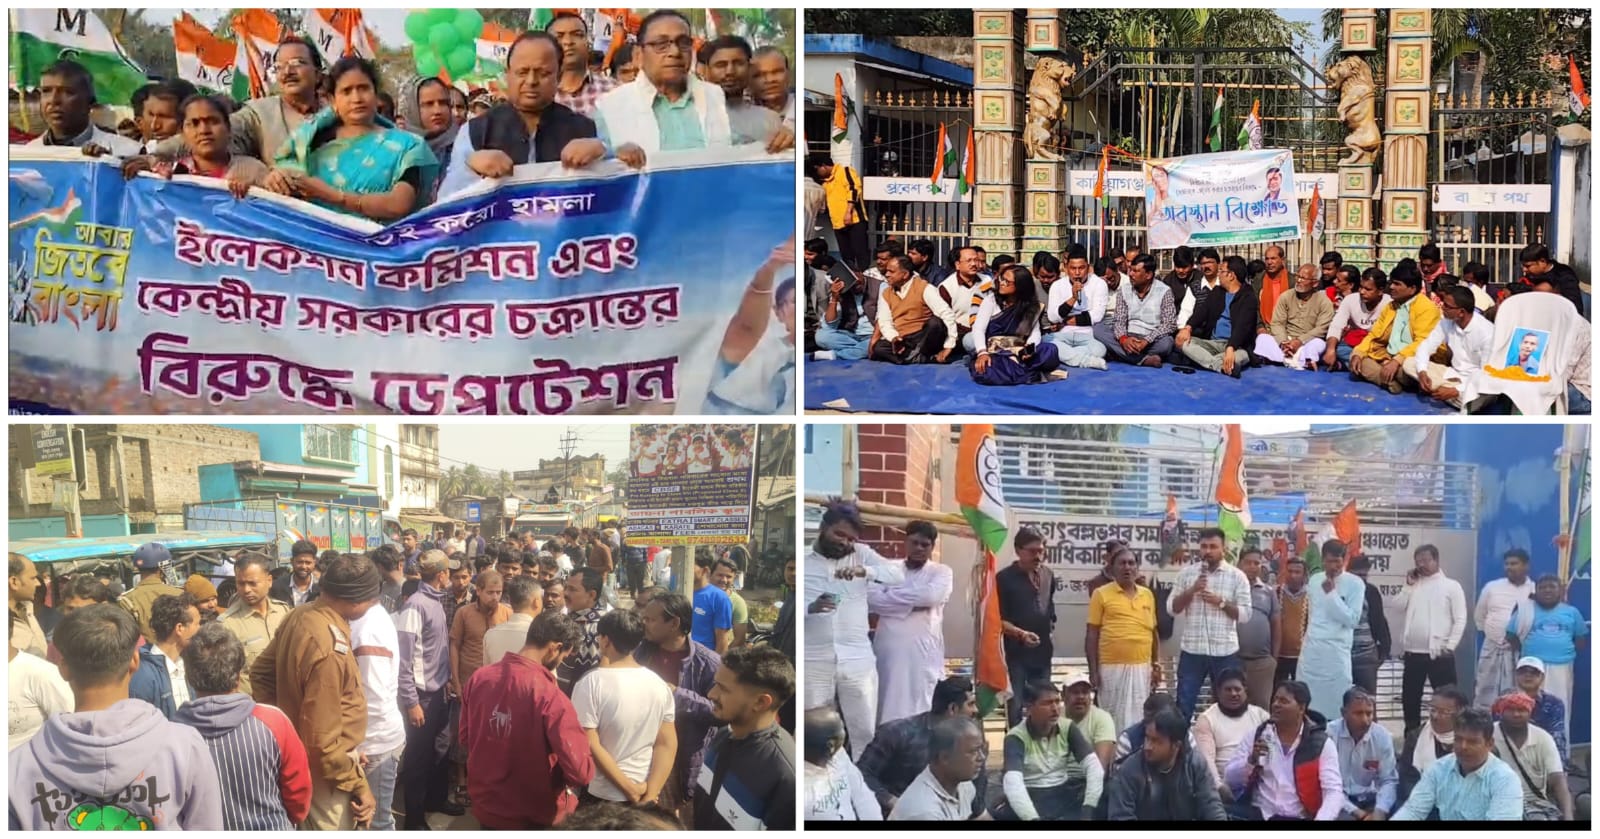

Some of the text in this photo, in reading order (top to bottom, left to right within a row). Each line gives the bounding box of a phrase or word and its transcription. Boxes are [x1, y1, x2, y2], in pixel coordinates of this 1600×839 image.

[509, 192, 596, 218] হামলা
[1503, 192, 1532, 204] পথ
[33, 227, 130, 287] জিতবে
[75, 222, 134, 249] আবার
[176, 219, 638, 291] ইলেকশন কমিশন এবং
[31, 283, 126, 332] বাংলা
[137, 276, 682, 342] কেন্দ্রীয় সরকারের চক্রান্তের
[137, 332, 680, 415] বিরুদ্ধে ডেপটেশন
